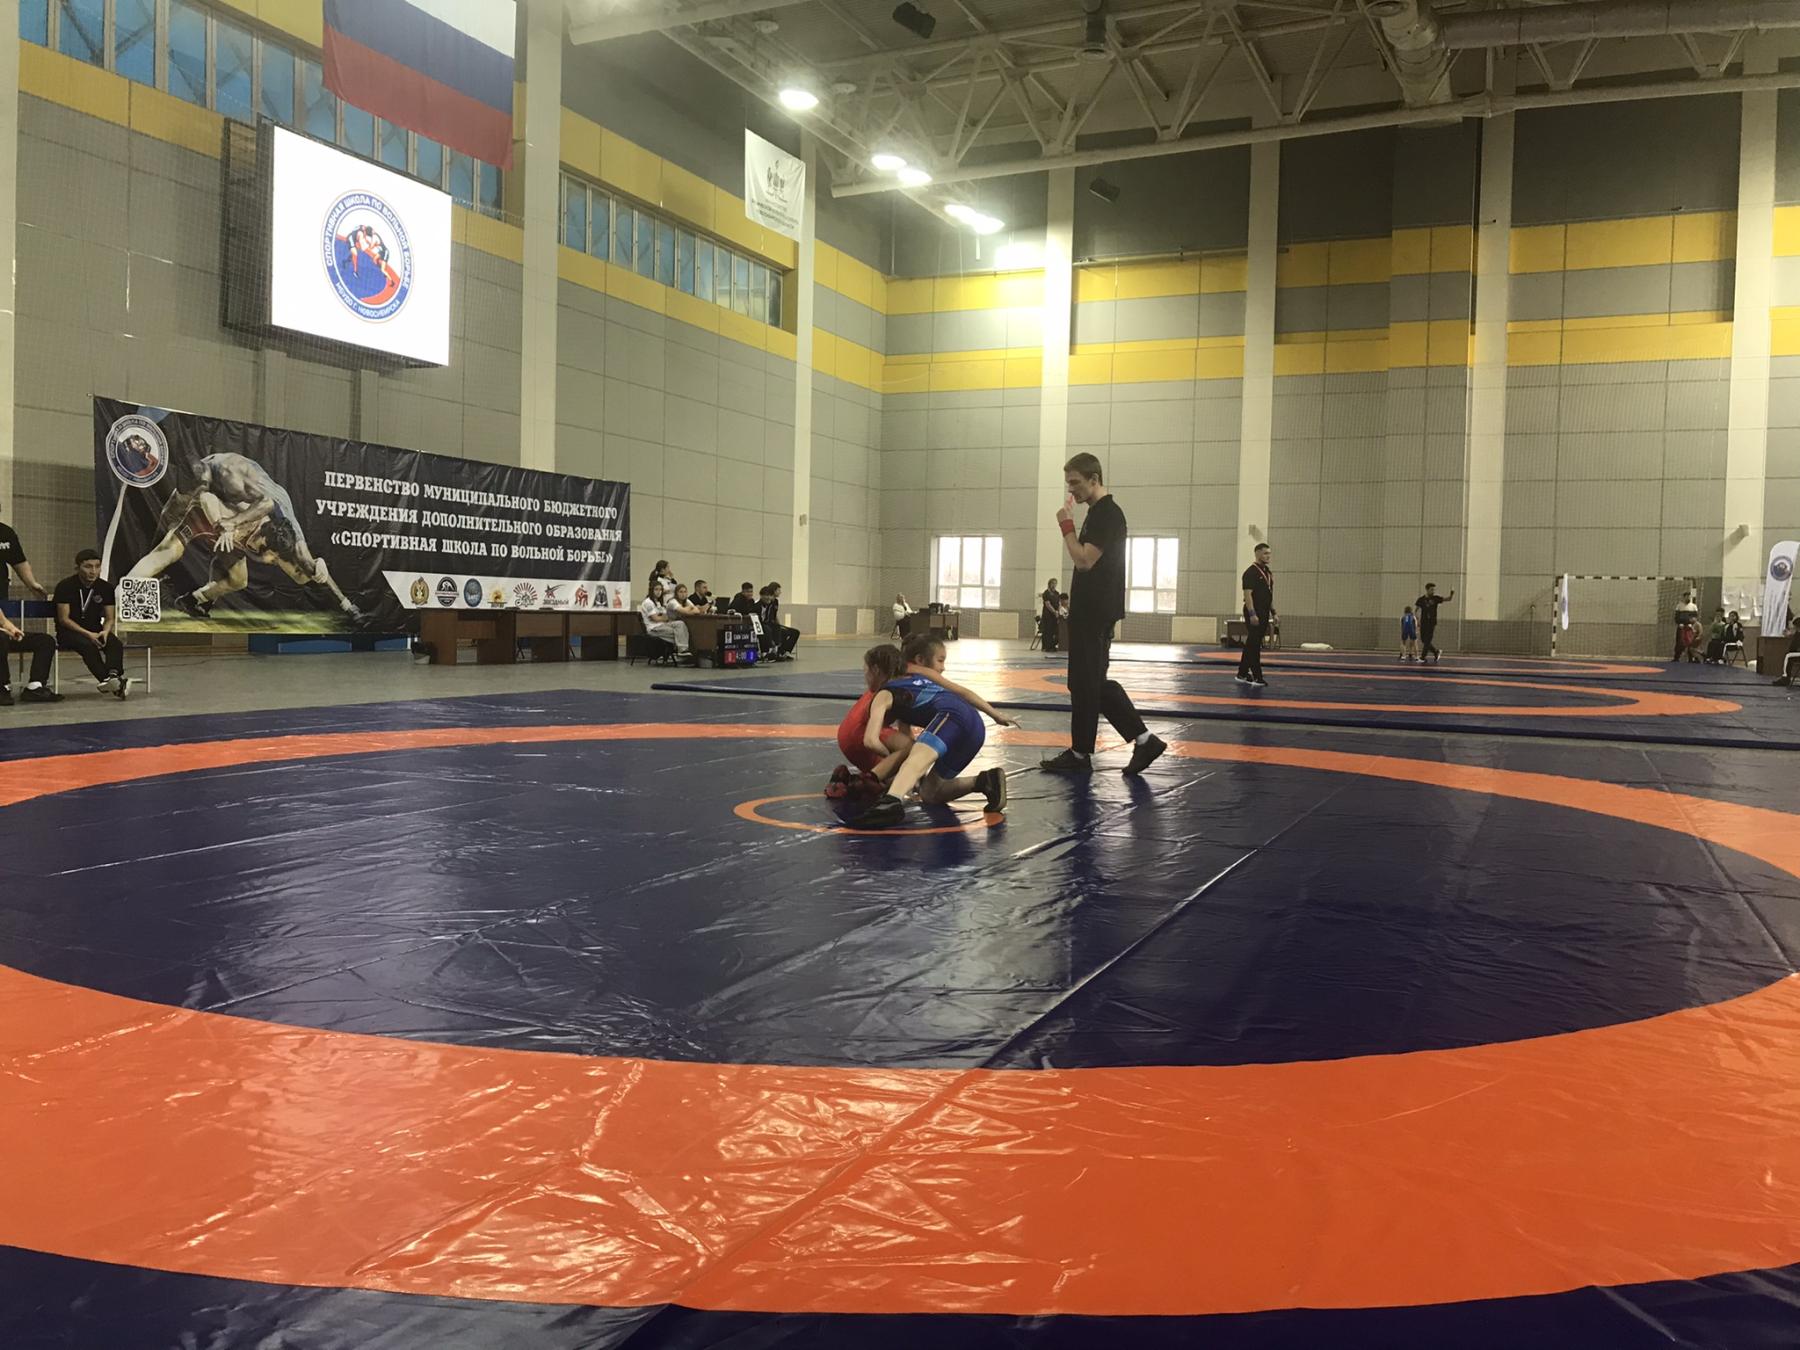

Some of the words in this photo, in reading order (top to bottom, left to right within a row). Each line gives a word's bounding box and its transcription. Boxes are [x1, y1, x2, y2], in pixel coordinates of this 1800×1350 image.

[324, 202, 345, 267] СПОРТИВНАЯ
[343, 195, 370, 207] ШКОЛА
[371, 199, 382, 210] ПО
[324, 471, 419, 496] ПЕРВЕНСТВО
[424, 484, 540, 512] МУНИЦИПАЛЬНОГО
[544, 500, 617, 520] БЮДЖЕТНОГО
[316, 499, 418, 523] УЧРЕЖДЕНИЯ
[422, 511, 542, 535] ДОПОЛНИТЕЛЬНОГО
[546, 525, 622, 542] ОБРАЗОВАНИЯ
[331, 531, 437, 552] «СПОРТИВНАЯ
[442, 539, 487, 556] ШКОЛА
[491, 544, 507, 557] ПО
[511, 545, 564, 561] ВОЛЬНОЙ
